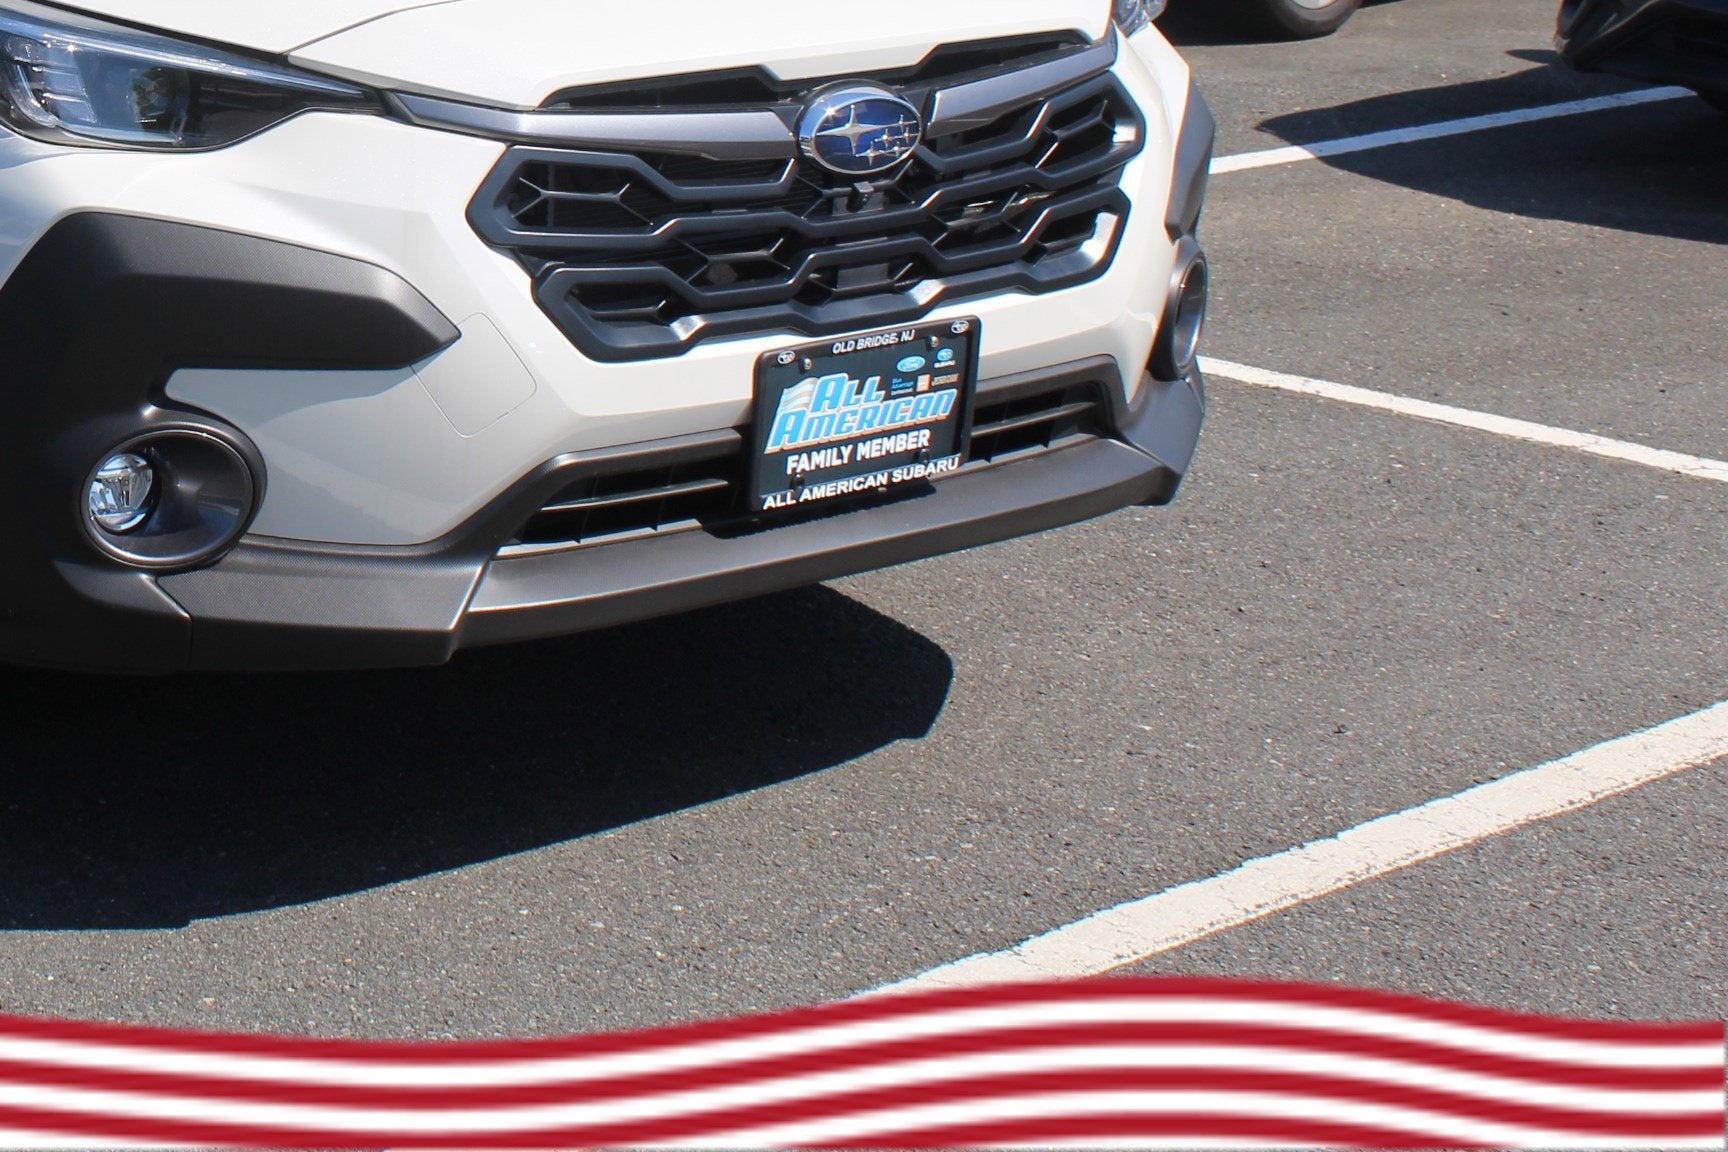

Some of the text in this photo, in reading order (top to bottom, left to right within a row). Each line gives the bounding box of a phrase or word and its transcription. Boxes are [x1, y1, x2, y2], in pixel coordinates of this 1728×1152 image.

[832, 340, 855, 354] OLD
[900, 329, 916, 342] NJ
[786, 429, 930, 476] FAMILY MEMBER
[762, 456, 961, 510] ALL AMERICAN SUBARU
